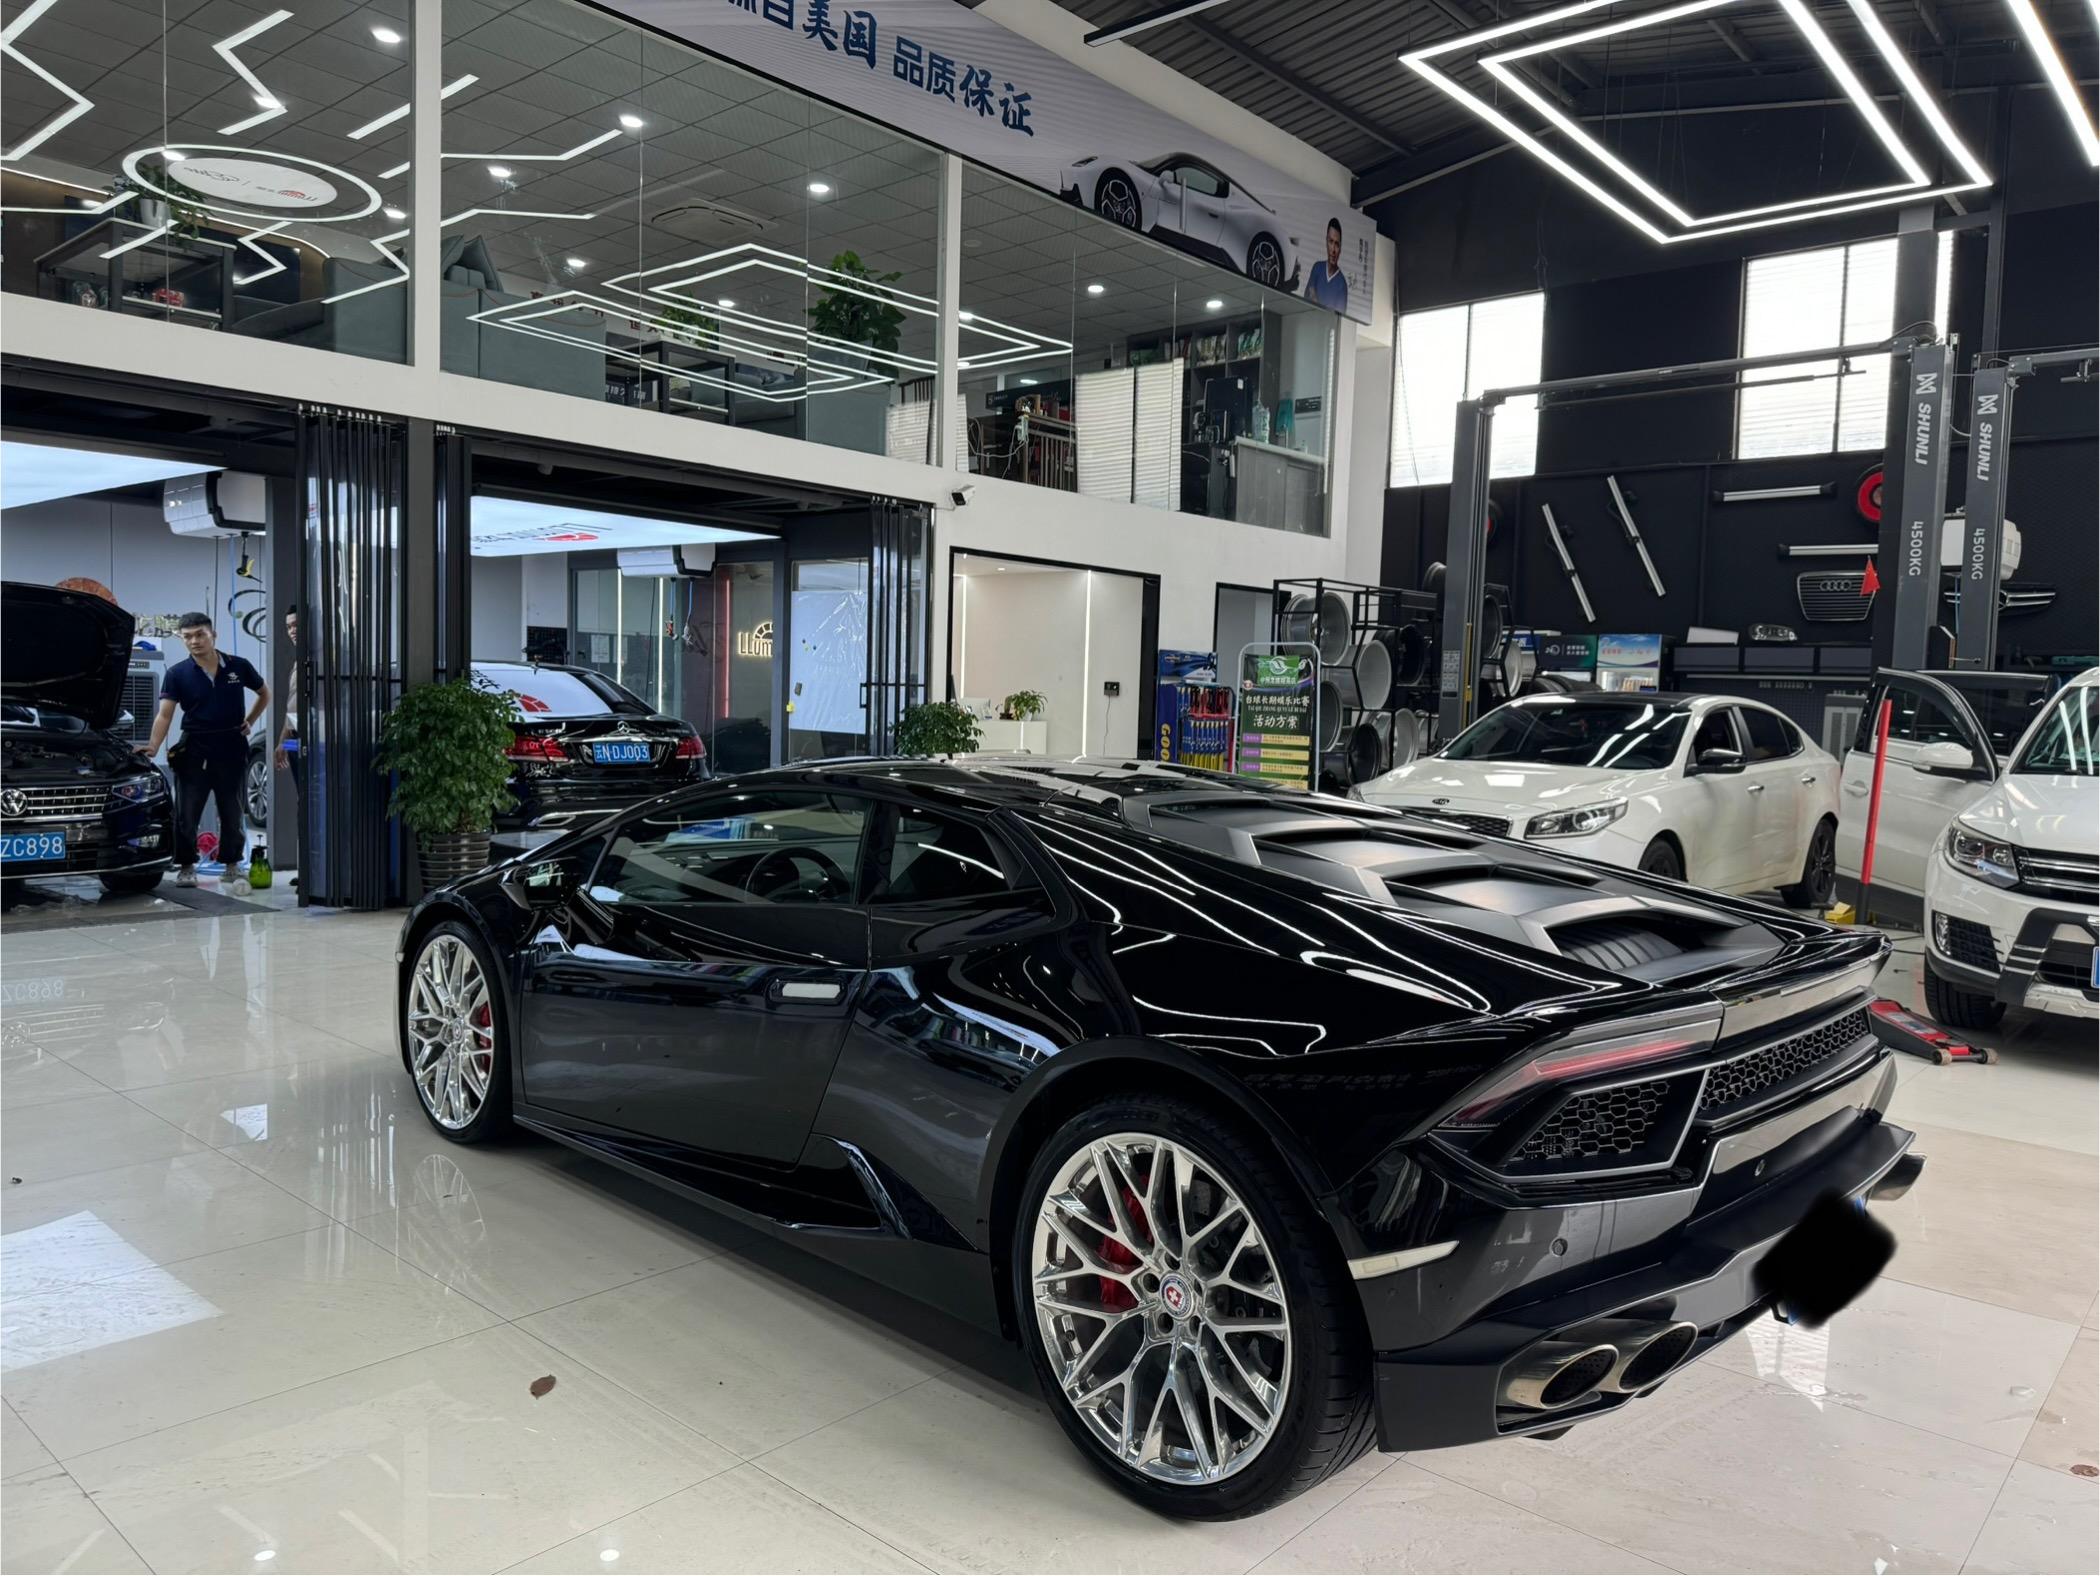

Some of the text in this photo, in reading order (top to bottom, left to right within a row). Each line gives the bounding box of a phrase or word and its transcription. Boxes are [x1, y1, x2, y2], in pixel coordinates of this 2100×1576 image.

[728, 0, 1034, 137] 自美国 品质保证
[1915, 403, 1931, 464] SHUNLI
[1977, 422, 1992, 481] SHUNLI
[1908, 521, 1924, 576] 4500KG
[1971, 528, 1986, 580] 4500KG
[1253, 714, 1298, 729] 活动方案
